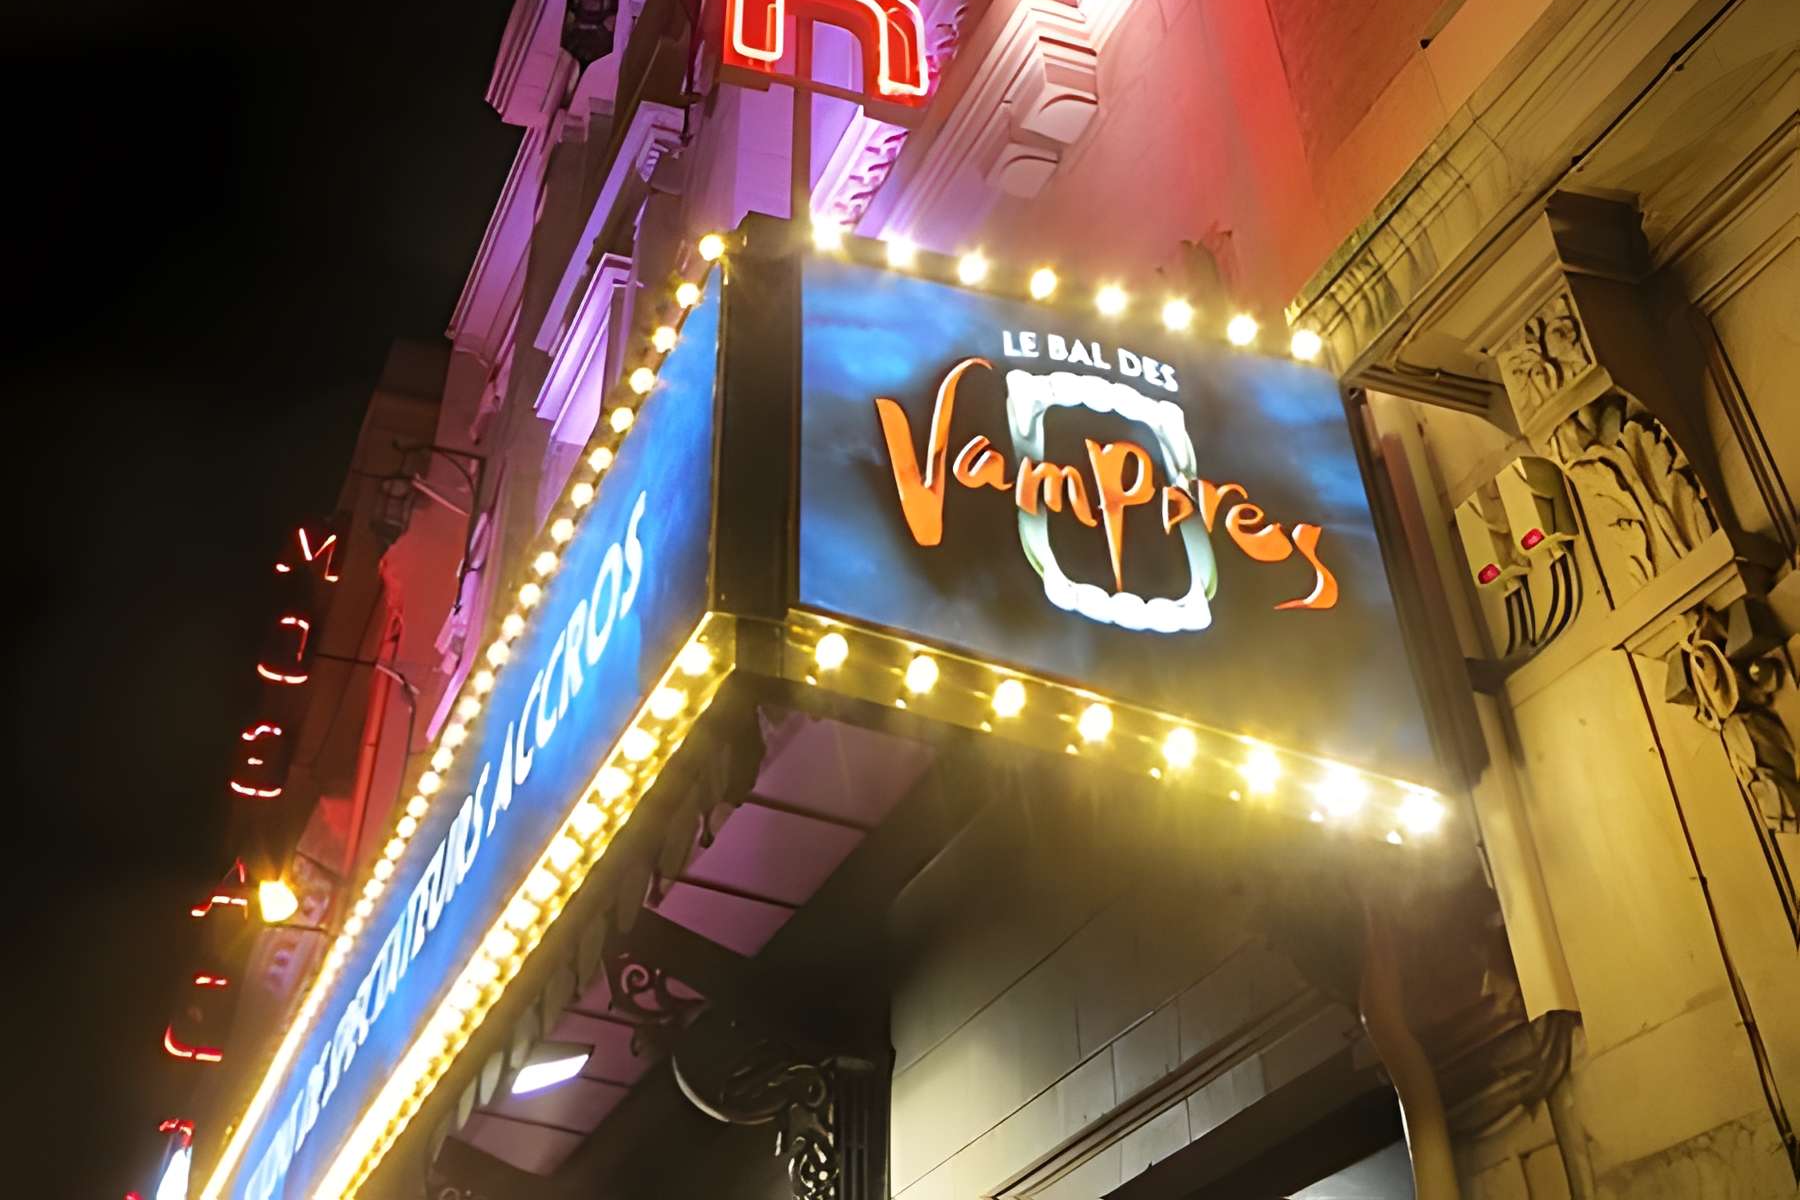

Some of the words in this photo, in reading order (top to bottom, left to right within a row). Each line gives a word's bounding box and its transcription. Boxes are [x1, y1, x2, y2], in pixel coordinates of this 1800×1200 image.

[1003, 330, 1039, 357] LE
[1048, 334, 1111, 370] BAL
[1117, 347, 1178, 392] DES
[486, 489, 646, 838] ACCROS
